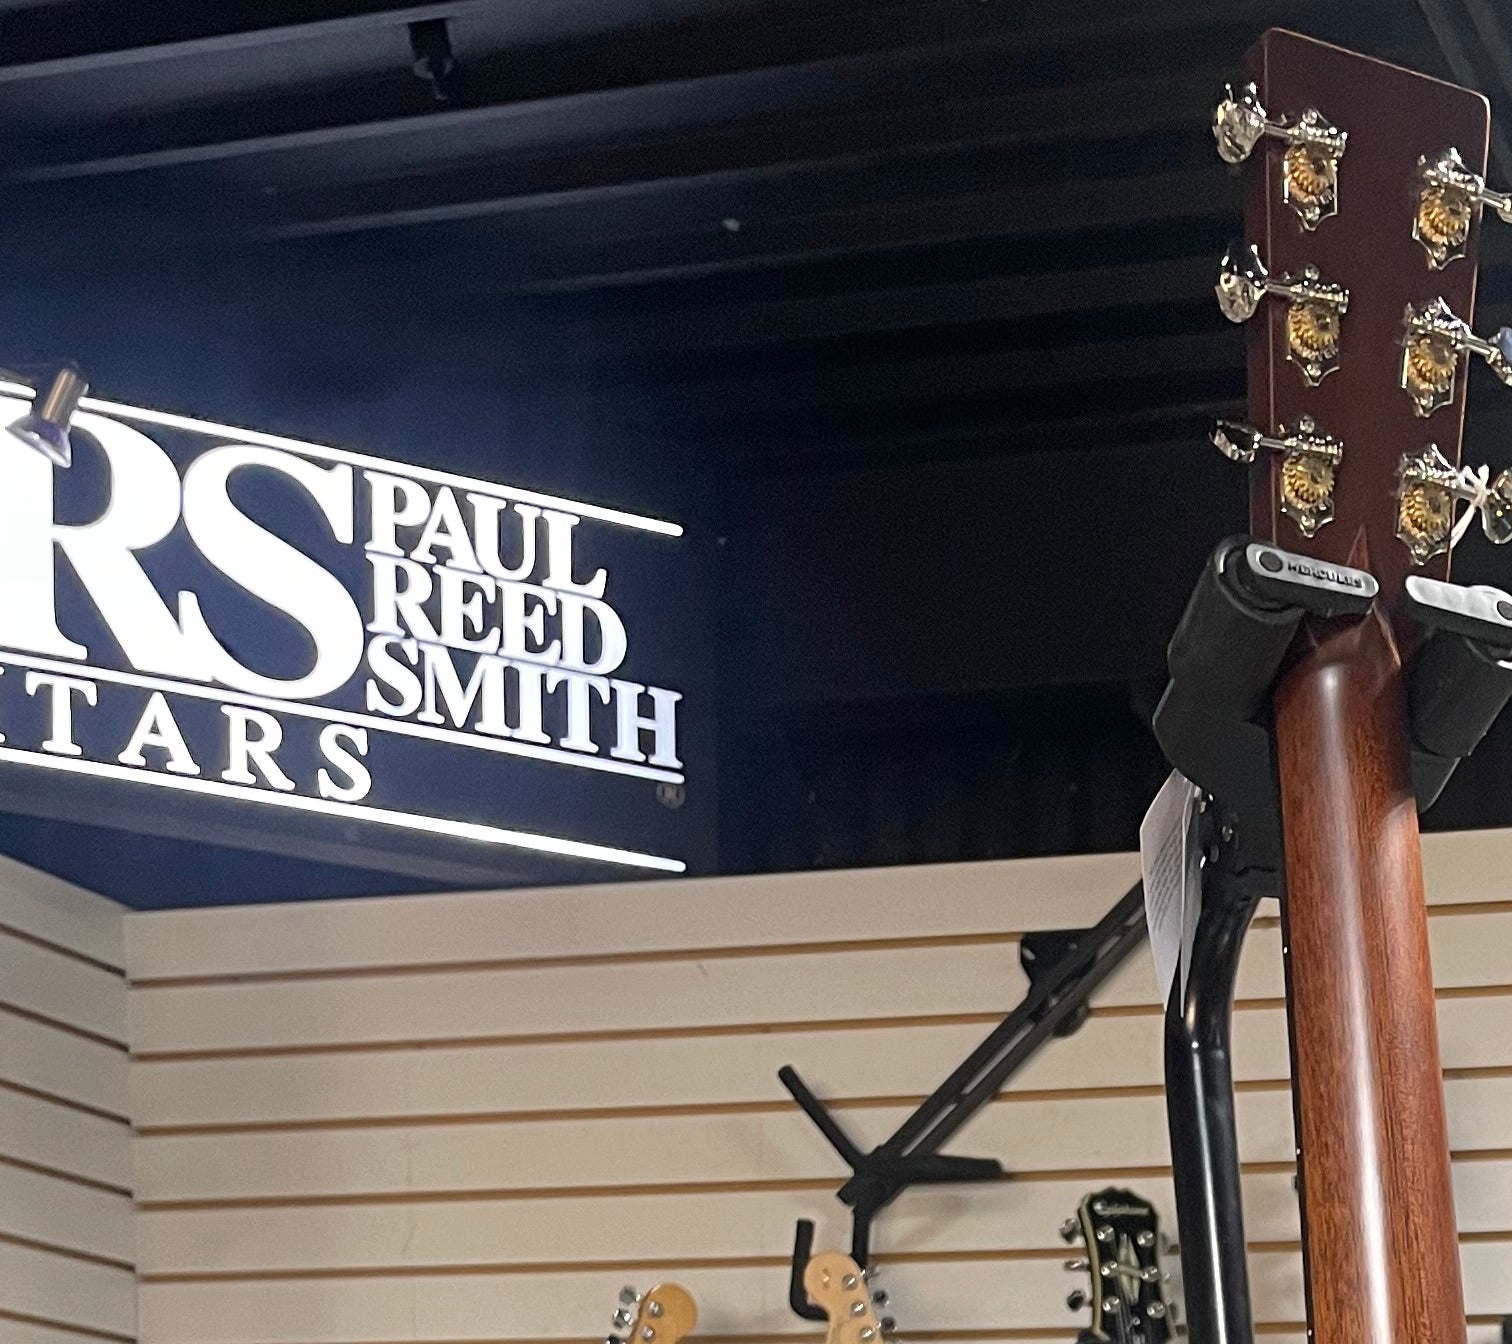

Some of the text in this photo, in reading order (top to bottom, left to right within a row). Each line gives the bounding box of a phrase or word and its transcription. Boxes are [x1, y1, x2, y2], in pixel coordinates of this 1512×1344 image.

[363, 470, 607, 598] PAUL
[364, 549, 628, 675] REED
[364, 633, 684, 769] SMITH
